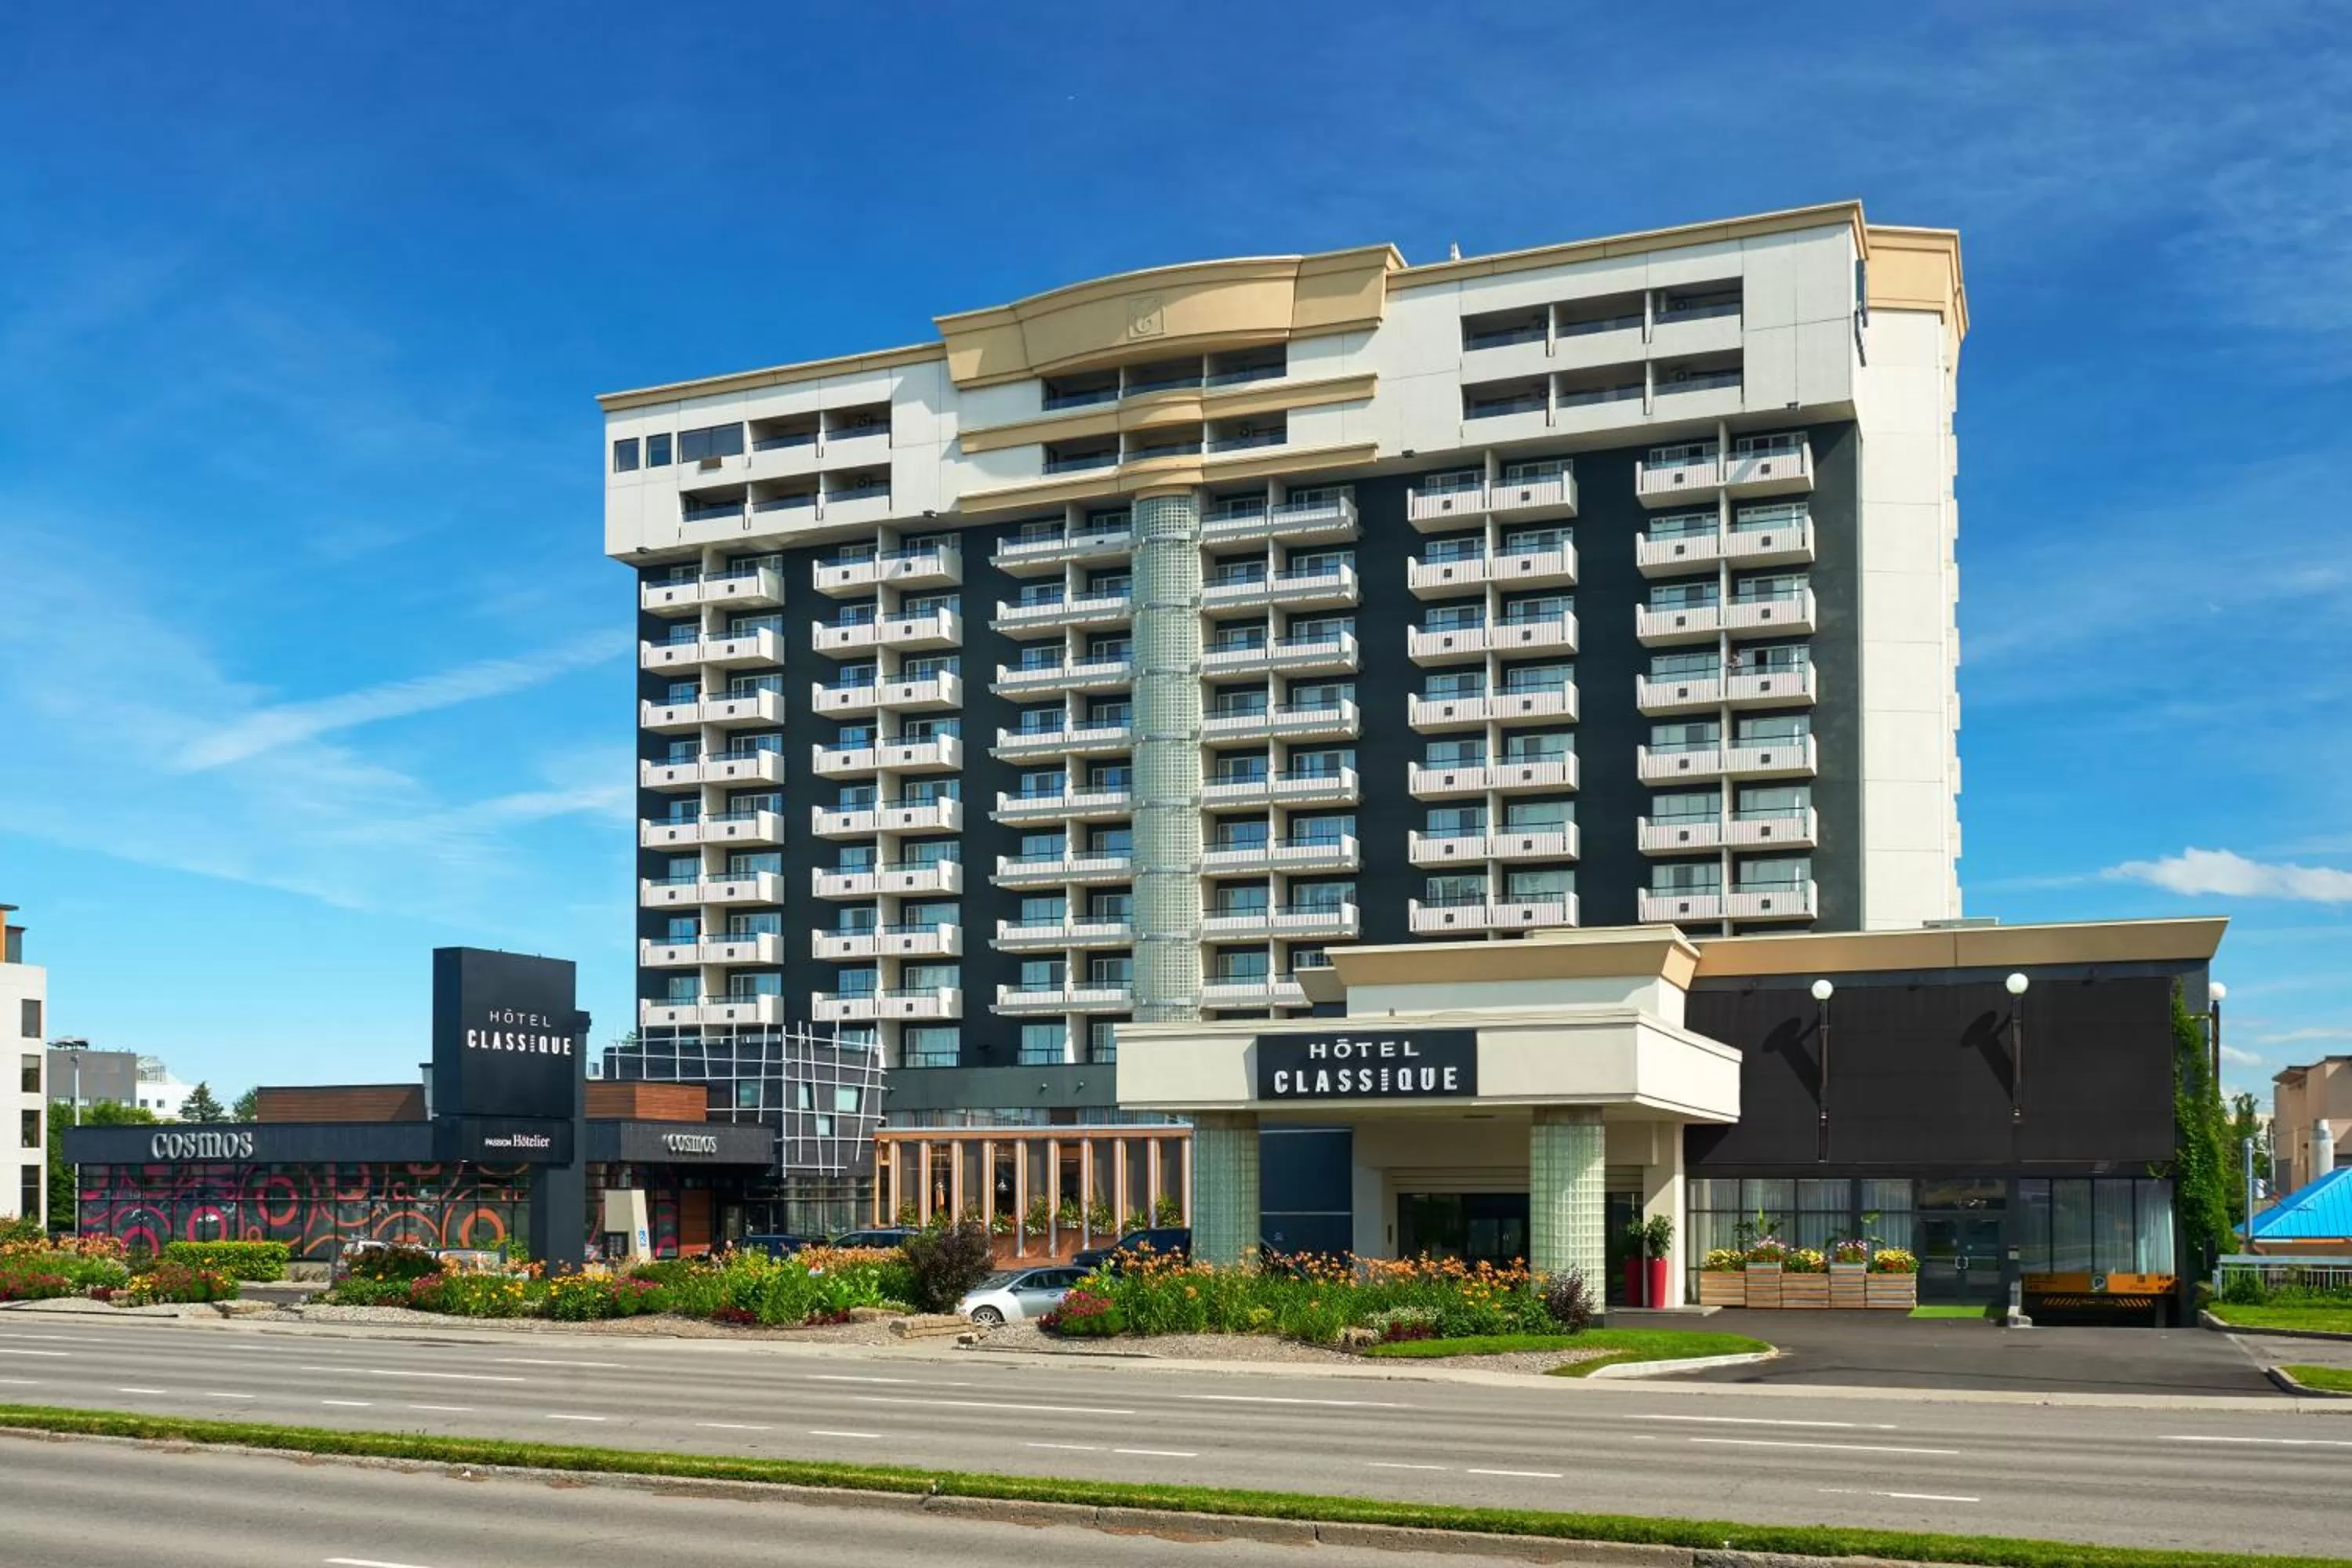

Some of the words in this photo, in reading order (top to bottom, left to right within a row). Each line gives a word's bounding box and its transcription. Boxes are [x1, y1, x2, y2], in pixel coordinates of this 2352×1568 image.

[489, 1007, 551, 1028] HÔTEL
[467, 1029, 572, 1056] CLASSIQUE
[1309, 1039, 1420, 1058] HÔTEL
[1274, 1066, 1457, 1093] CLASSIQUE
